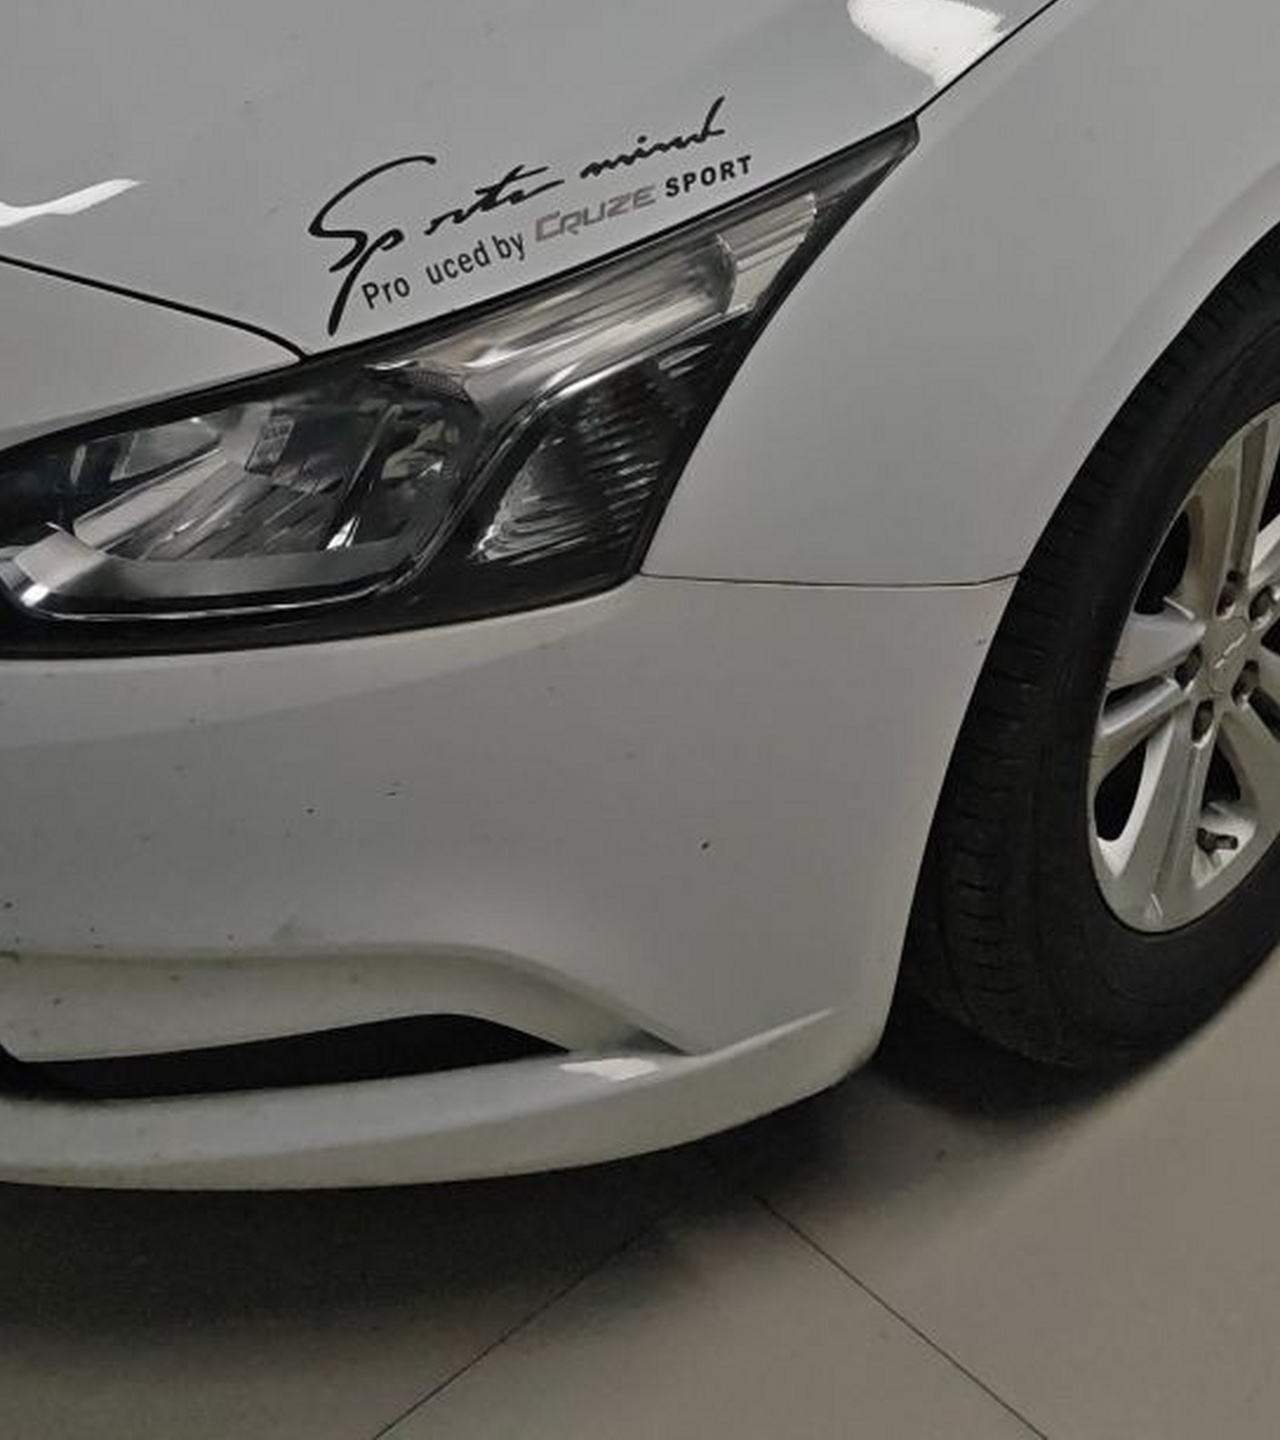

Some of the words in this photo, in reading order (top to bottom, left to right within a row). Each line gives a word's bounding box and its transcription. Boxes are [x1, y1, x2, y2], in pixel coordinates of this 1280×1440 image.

[580, 95, 726, 179] mind
[492, 234, 525, 261] by
[535, 185, 657, 243] CRUZE
[665, 155, 751, 198] SPORT
